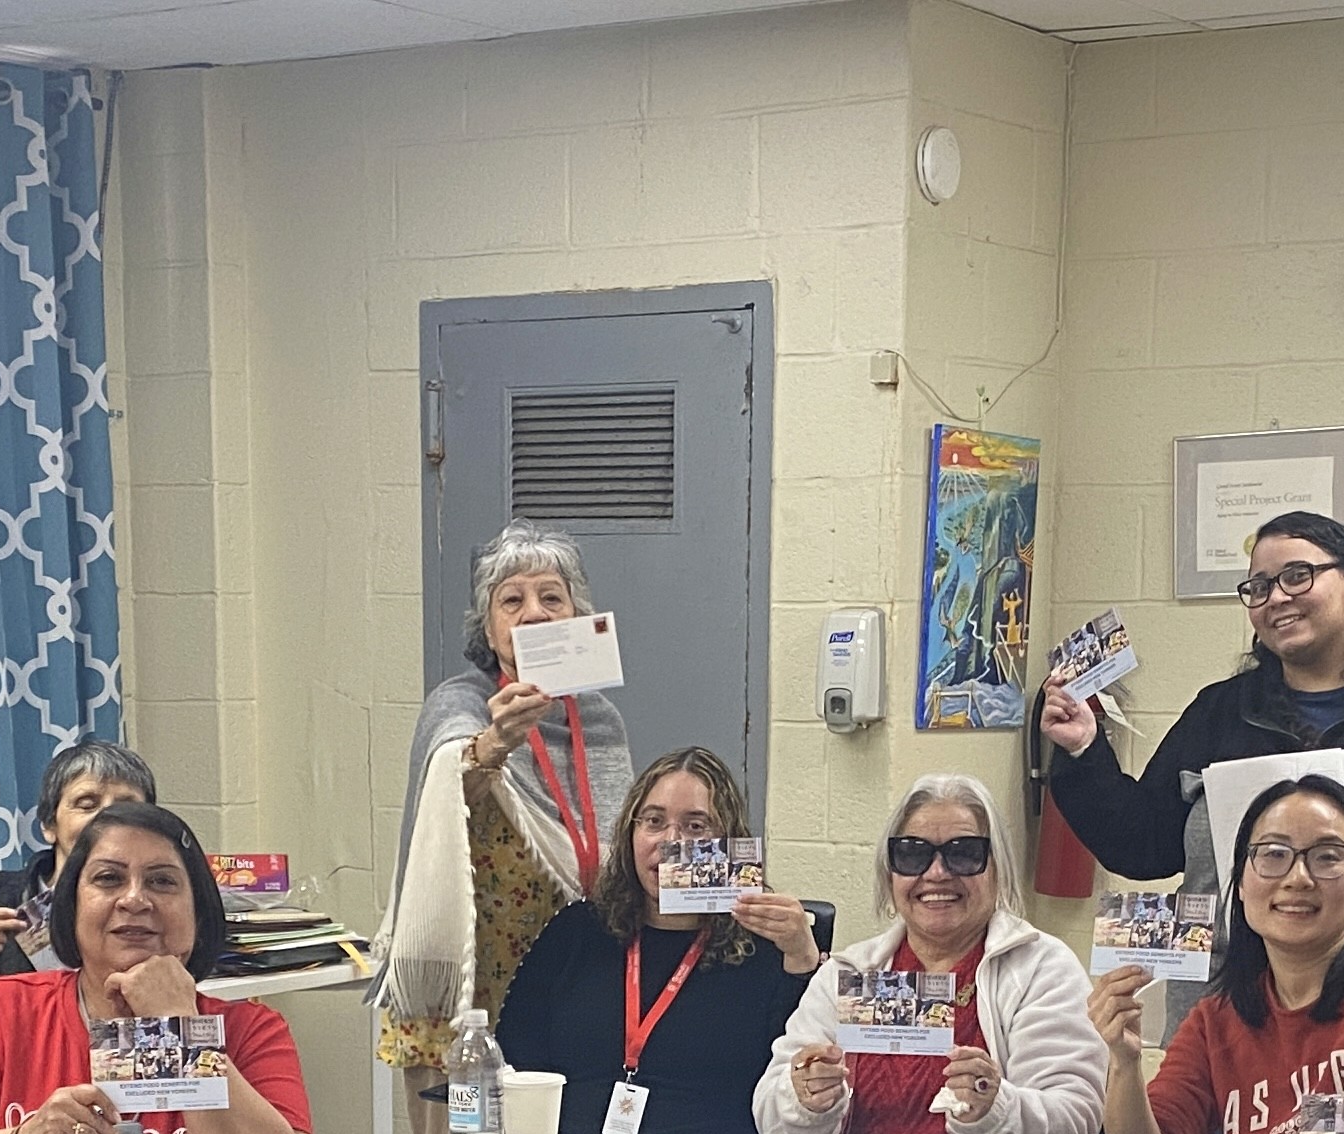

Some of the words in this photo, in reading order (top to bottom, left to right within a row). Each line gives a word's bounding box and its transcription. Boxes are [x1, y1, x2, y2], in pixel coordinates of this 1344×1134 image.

[1215, 494, 1247, 509] Special
[1249, 494, 1281, 506] Project
[1284, 492, 1312, 502] Grant
[236, 858, 255, 869] bits
